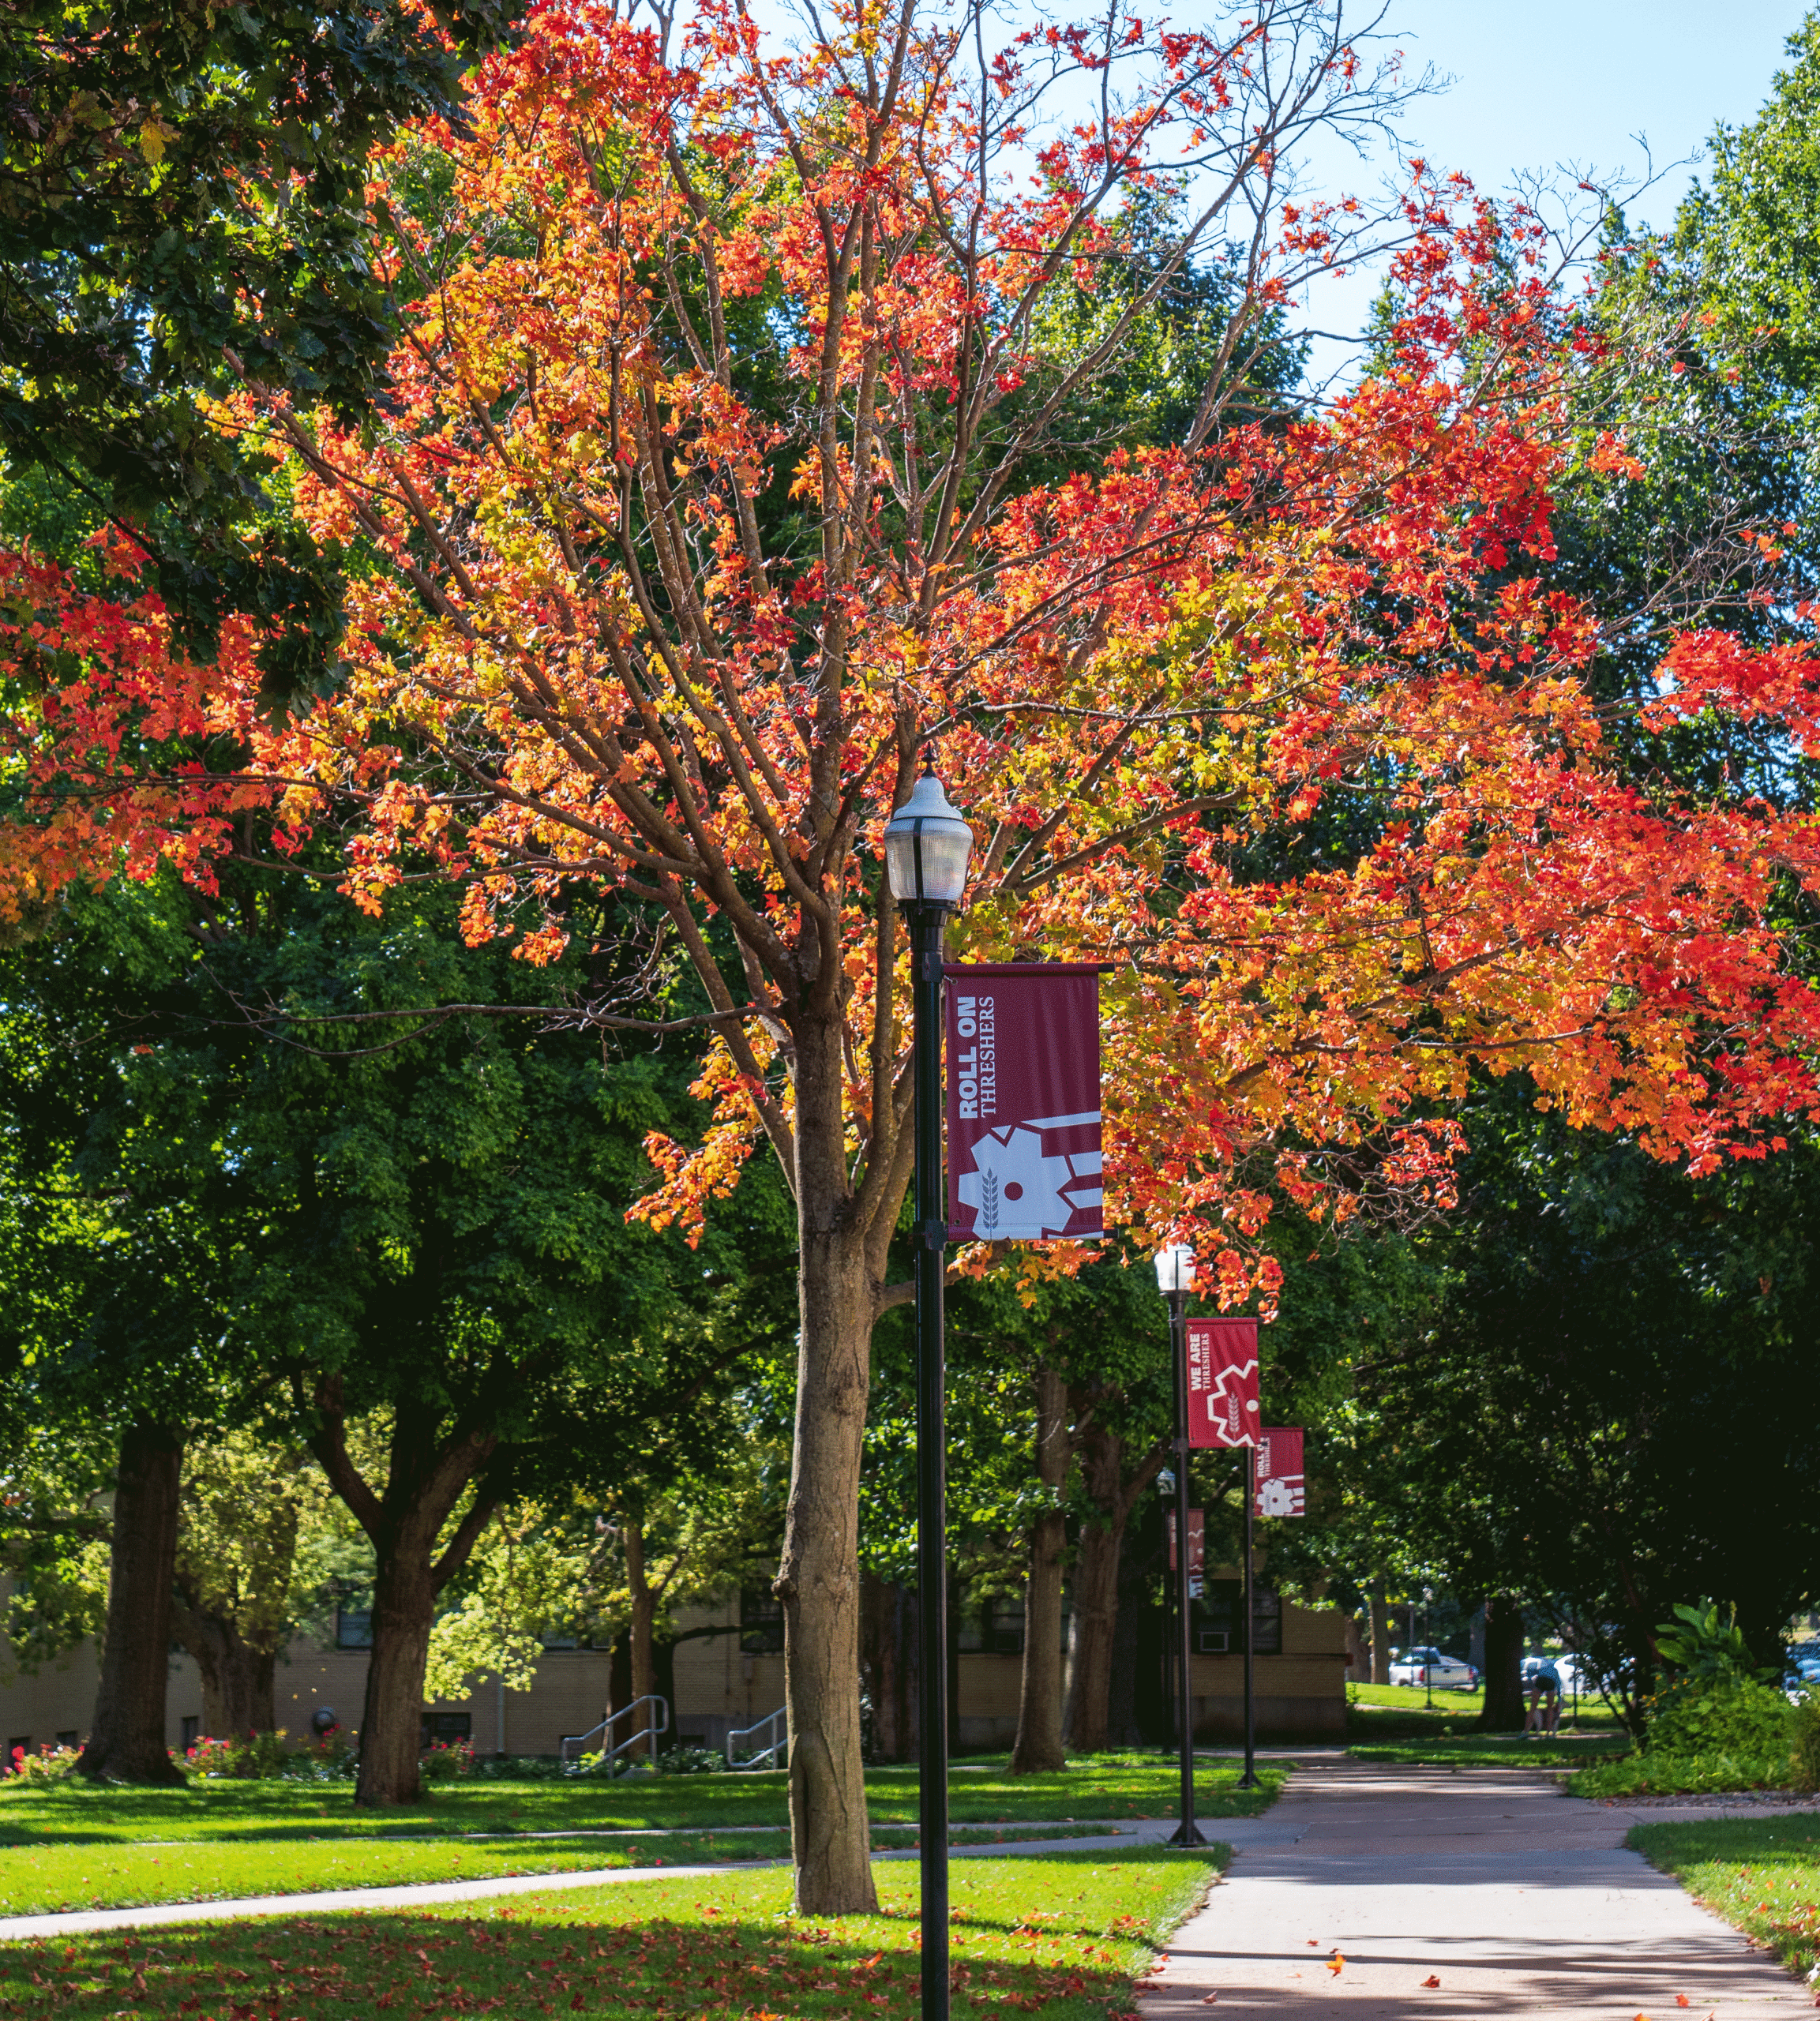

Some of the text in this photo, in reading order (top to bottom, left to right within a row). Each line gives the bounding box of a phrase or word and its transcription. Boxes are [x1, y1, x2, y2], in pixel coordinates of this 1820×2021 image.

[958, 996, 978, 1119] ROLL ON
[979, 996, 996, 1118] THRESHERS
[1189, 1333, 1201, 1391] WE ARE
[1201, 1333, 1210, 1390] THRESHERS
